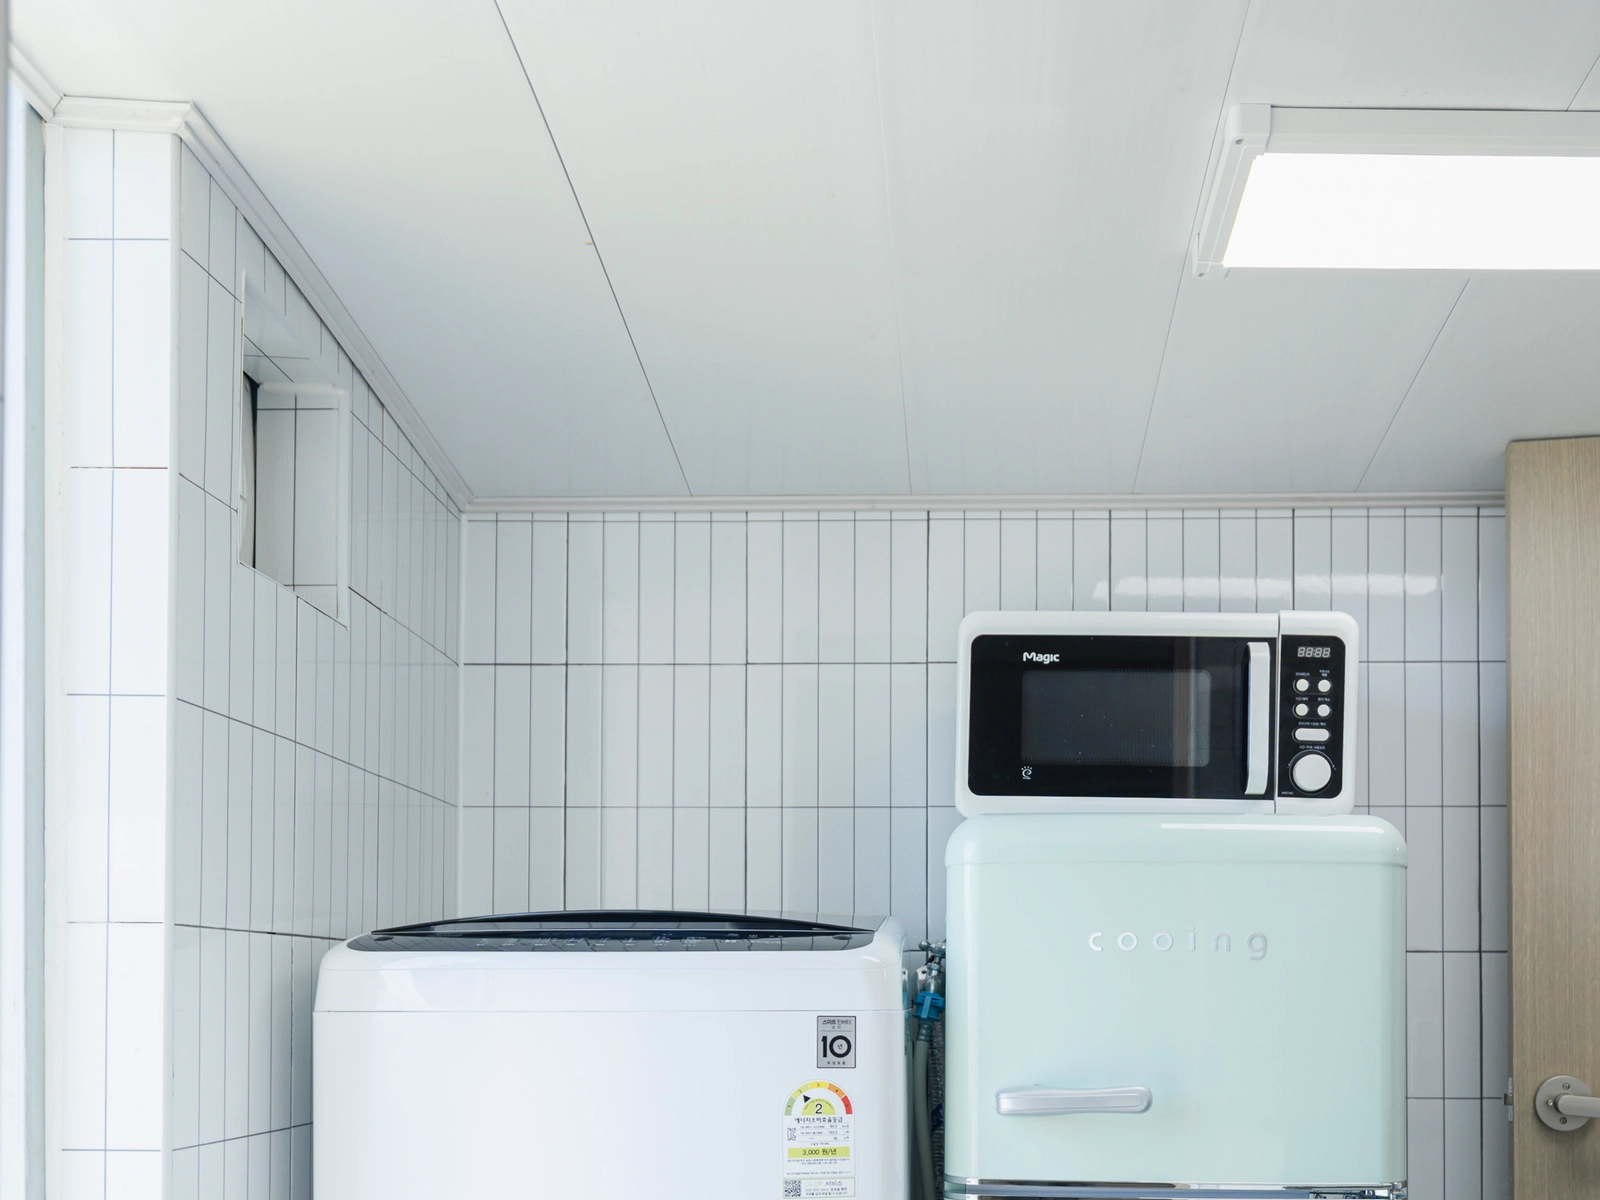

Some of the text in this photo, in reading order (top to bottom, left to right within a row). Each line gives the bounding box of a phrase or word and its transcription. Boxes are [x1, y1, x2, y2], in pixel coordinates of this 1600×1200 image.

[1023, 652, 1060, 664] Magic
[1088, 926, 1268, 961] cooing
[821, 1034, 852, 1058] 10
[815, 1103, 823, 1114] 2
